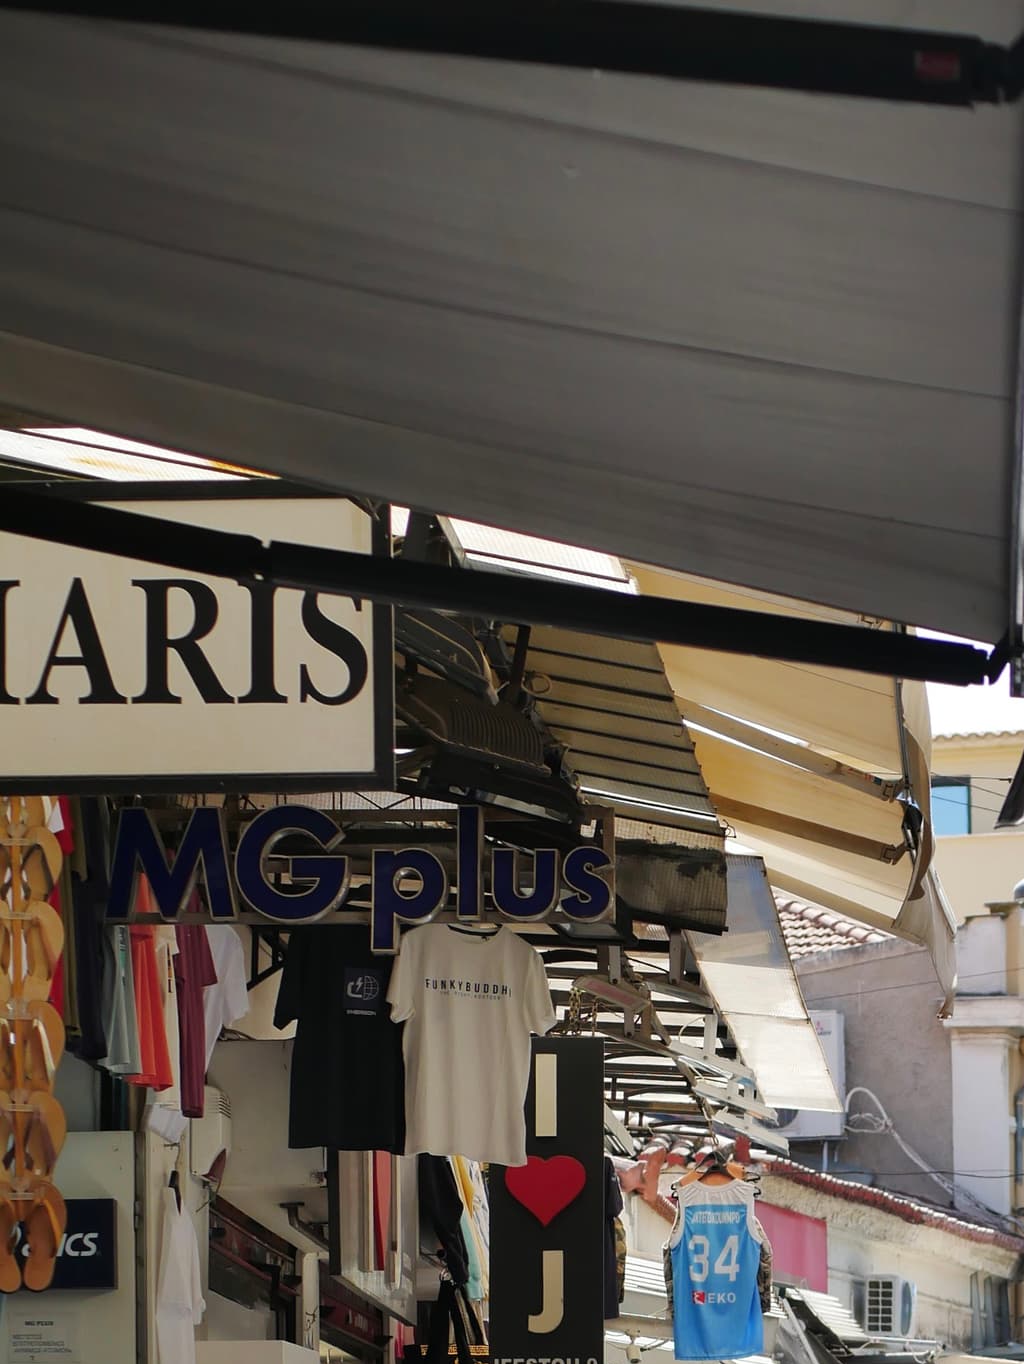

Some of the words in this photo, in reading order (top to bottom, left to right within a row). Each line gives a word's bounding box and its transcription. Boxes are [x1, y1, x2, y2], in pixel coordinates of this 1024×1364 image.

[106, 804, 351, 924] MG
[370, 804, 617, 955] plus
[687, 1234, 740, 1282] 34
[707, 1291, 737, 1304] EKO
